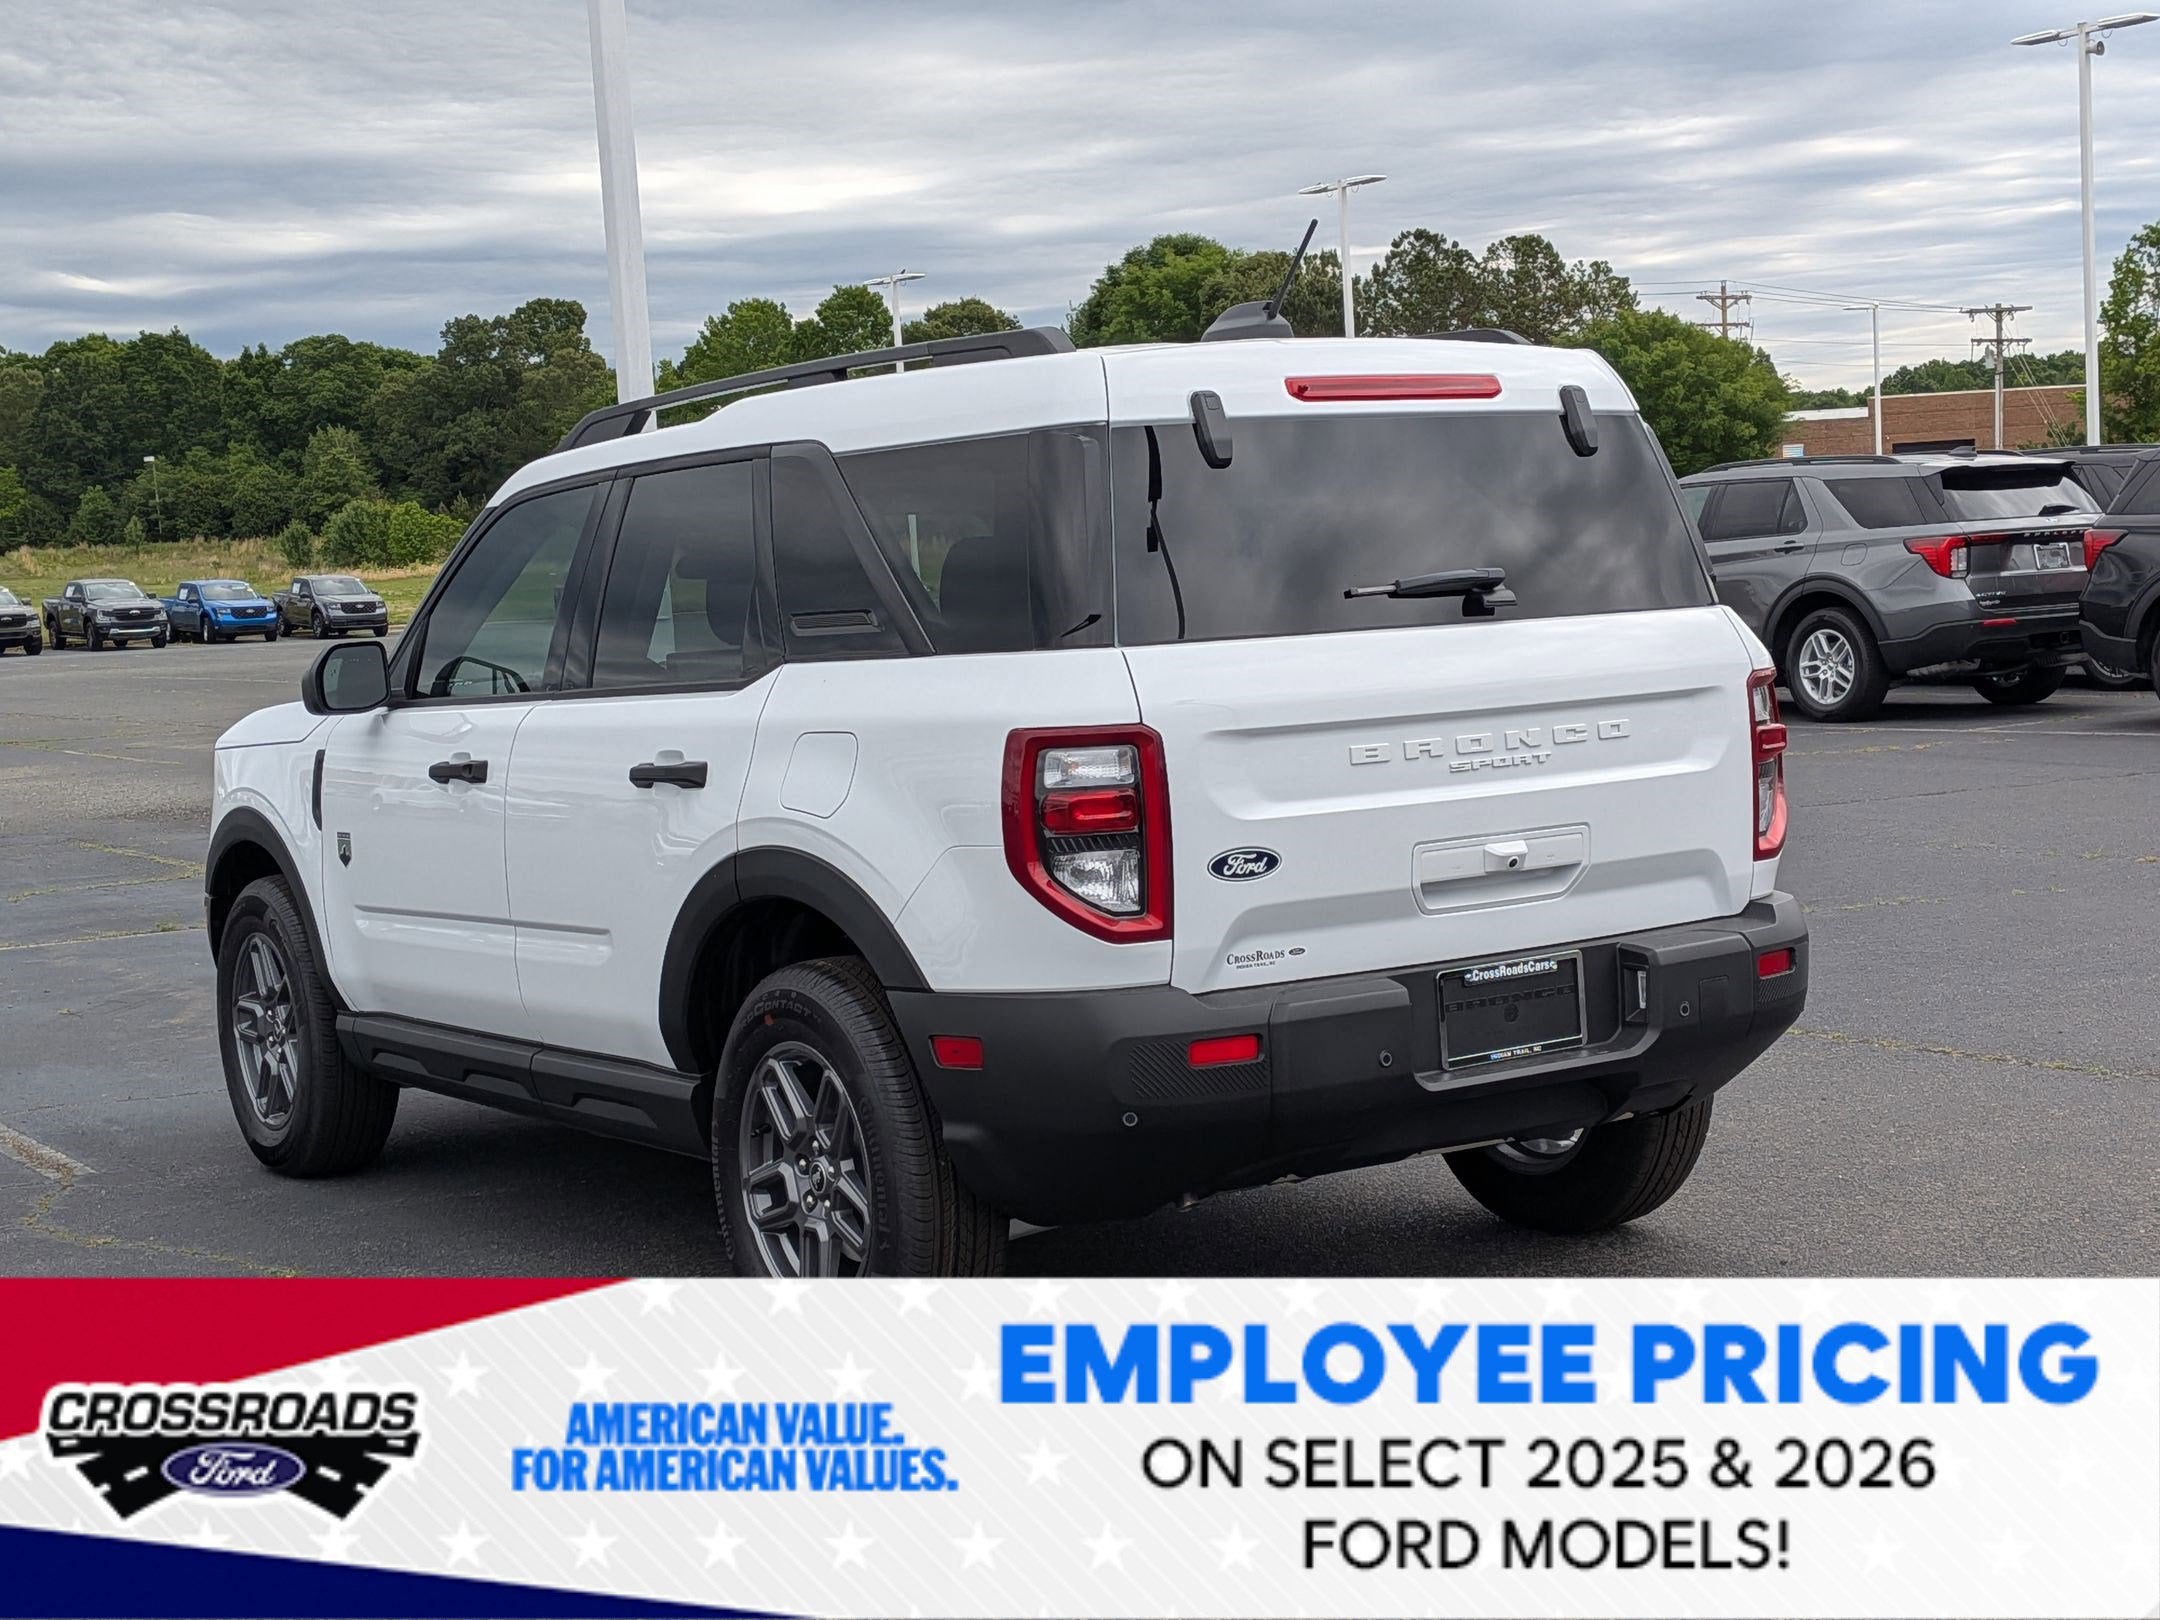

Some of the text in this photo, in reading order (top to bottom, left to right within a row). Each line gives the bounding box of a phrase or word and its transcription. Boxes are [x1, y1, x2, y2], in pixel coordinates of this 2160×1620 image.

[1350, 719, 1630, 765] BRONCO
[1450, 752, 1551, 773] SPORT
[1223, 853, 1268, 875] Ford
